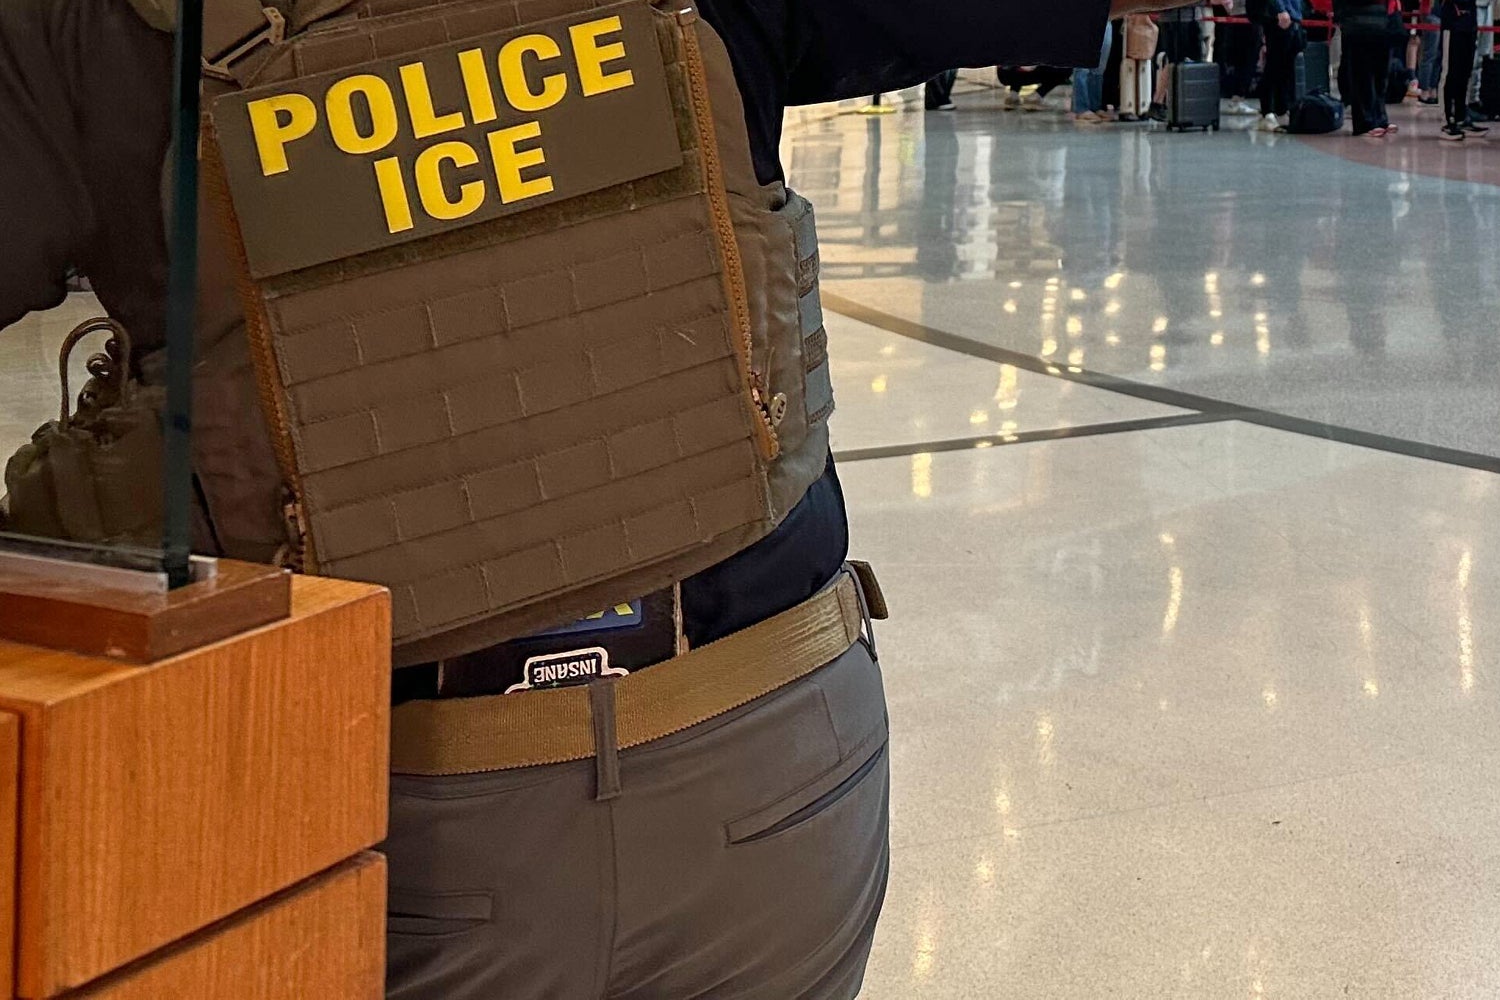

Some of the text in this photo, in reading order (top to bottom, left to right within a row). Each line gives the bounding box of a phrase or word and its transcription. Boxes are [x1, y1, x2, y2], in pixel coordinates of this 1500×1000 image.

[247, 15, 635, 177] POLICE
[373, 120, 554, 234] ICE
[533, 658, 598, 684] INSANE
